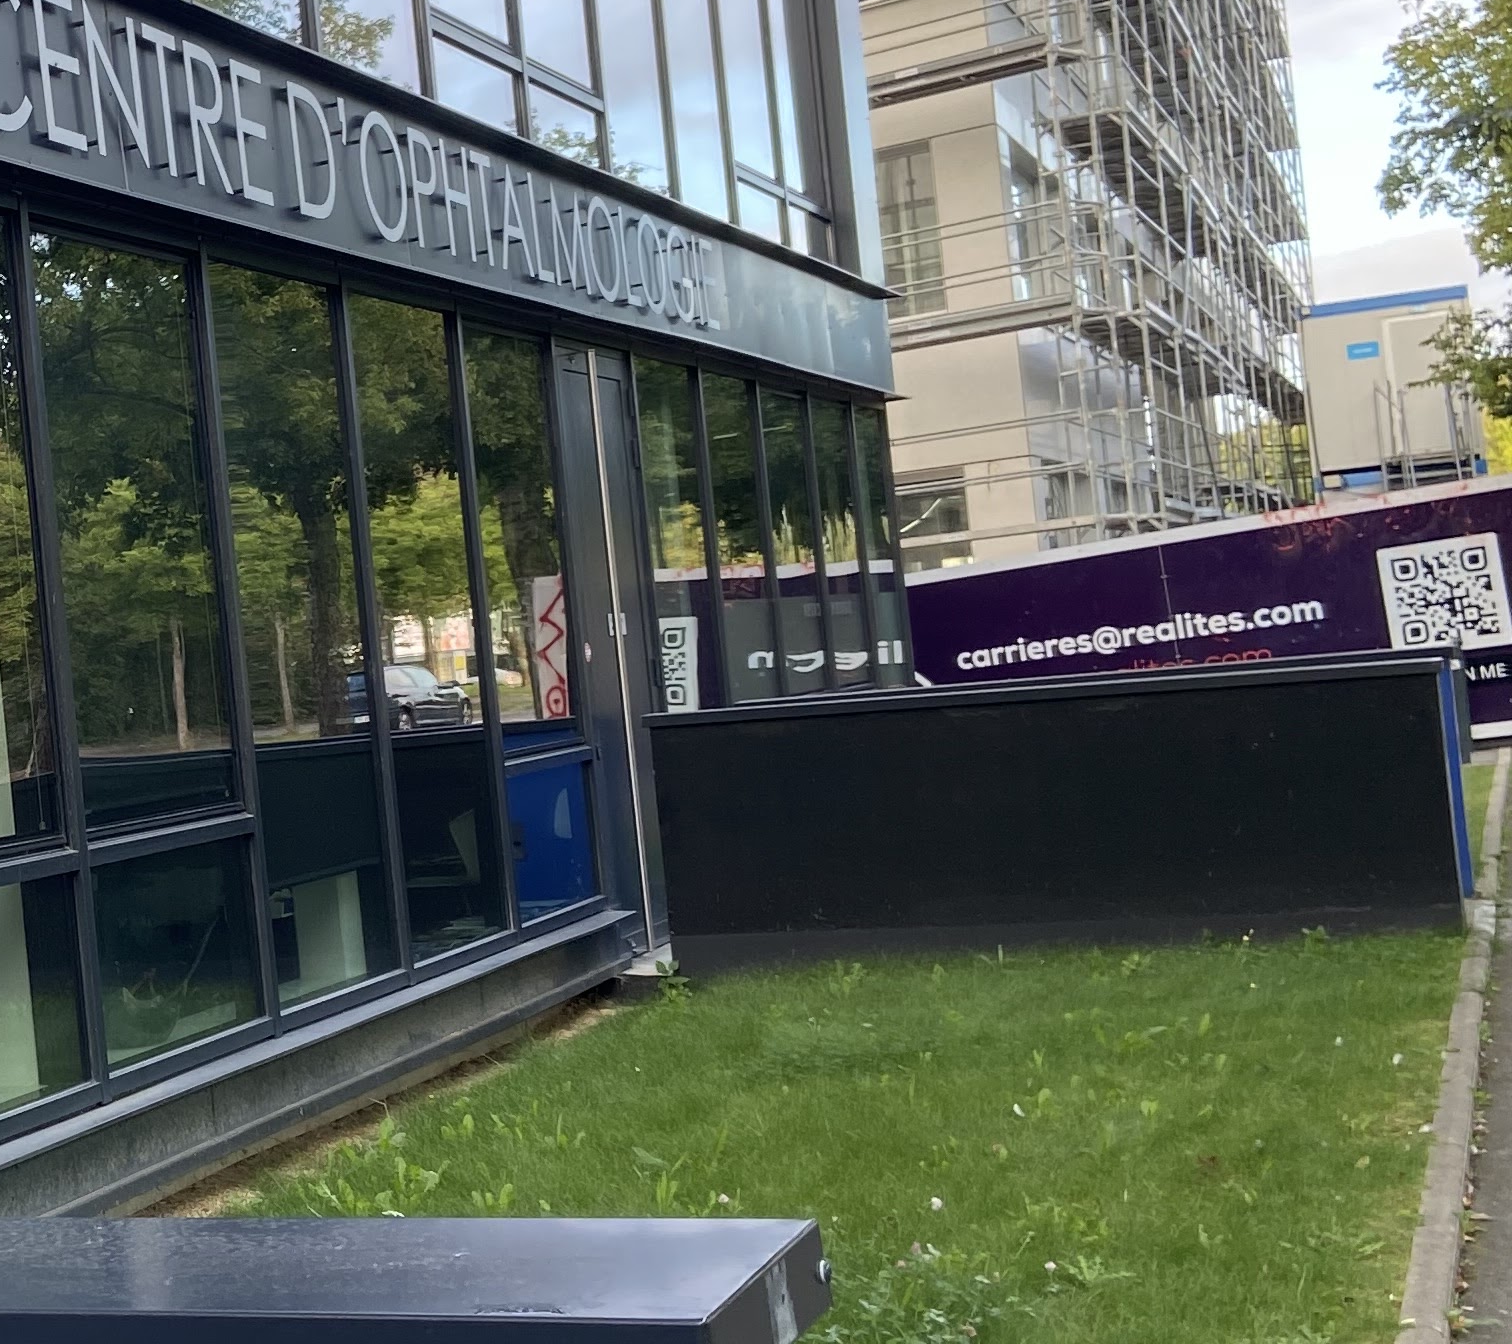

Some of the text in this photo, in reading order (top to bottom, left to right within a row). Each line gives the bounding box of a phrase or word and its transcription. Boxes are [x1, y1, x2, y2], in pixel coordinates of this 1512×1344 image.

[286, 80, 721, 331] D'OPHTALMOLOGIE
[956, 599, 1325, 671] carrieres@realites.com
[1480, 662, 1508, 680] ME
